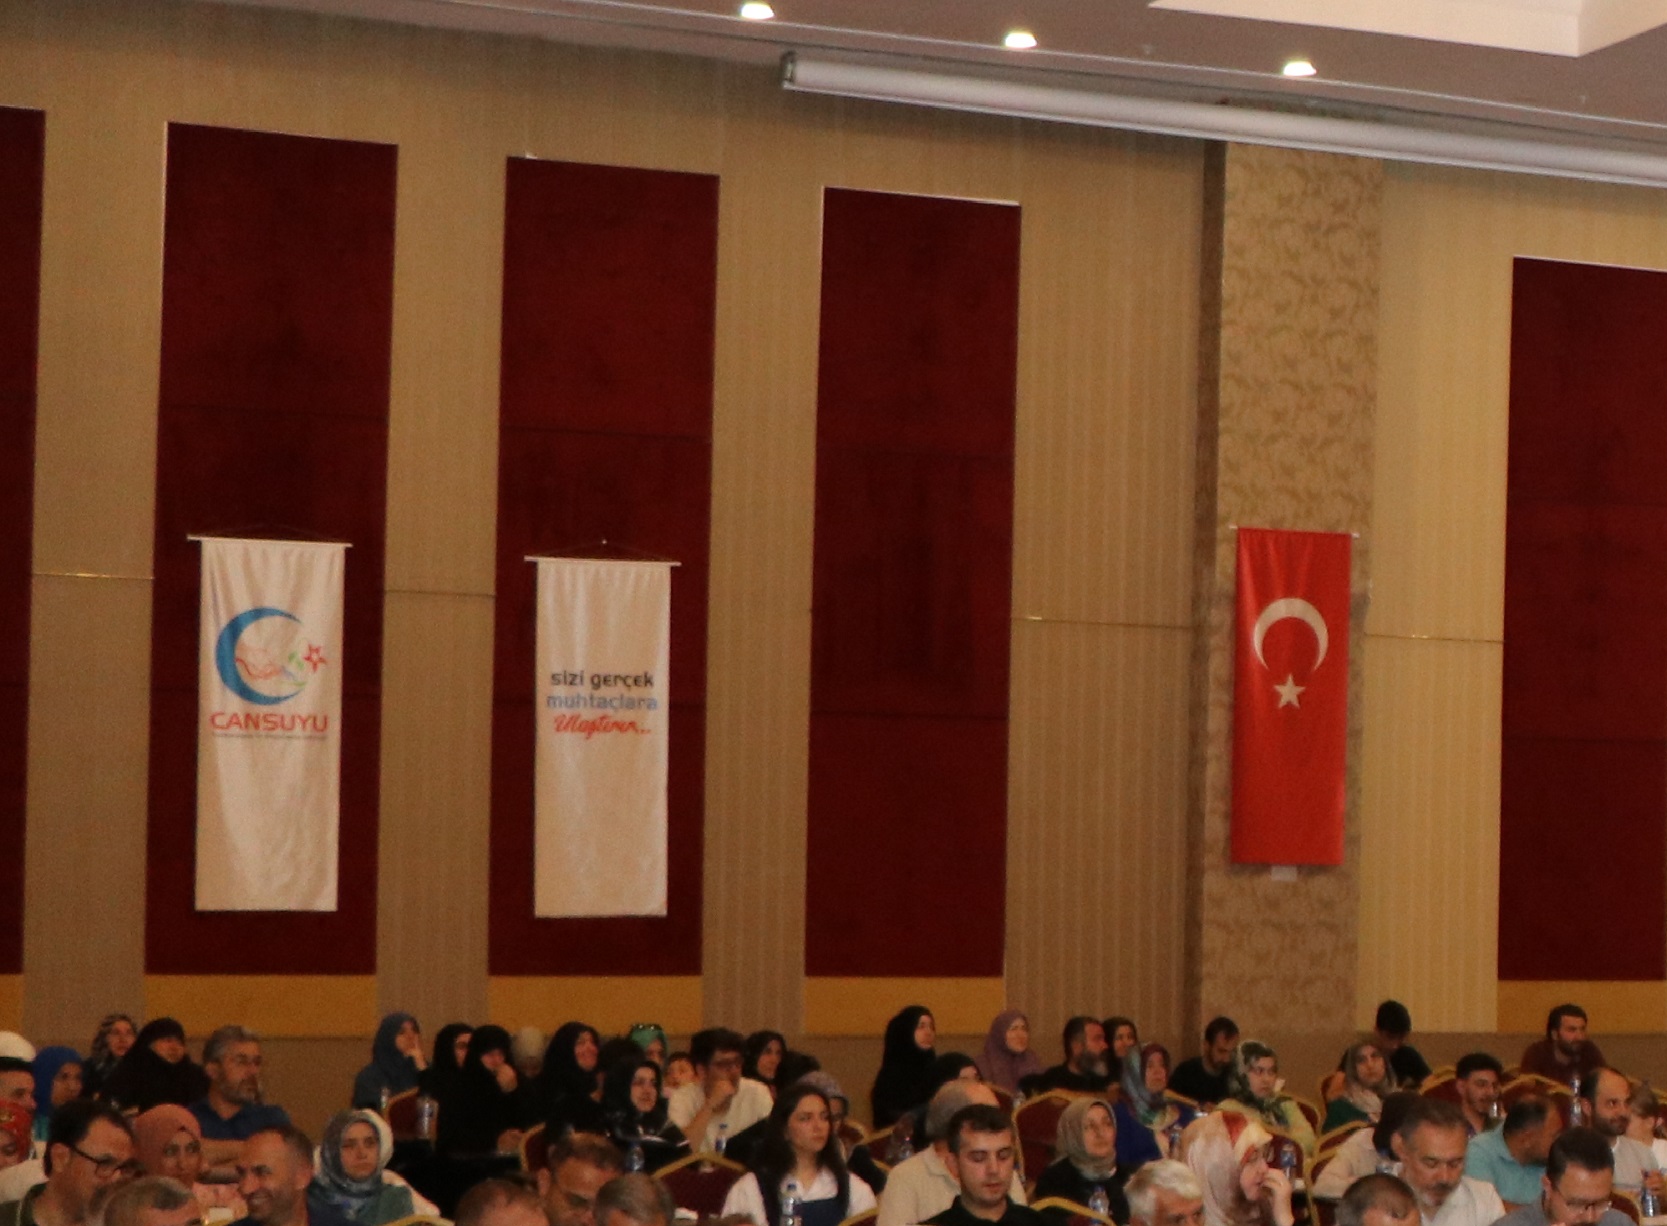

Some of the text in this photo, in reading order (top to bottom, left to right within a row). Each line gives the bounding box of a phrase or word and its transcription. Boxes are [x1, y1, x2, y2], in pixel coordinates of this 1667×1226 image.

[551, 670, 654, 691] sizi gerçek
[546, 693, 657, 712] muhtaçlara
[209, 711, 328, 732] CANSUYU
